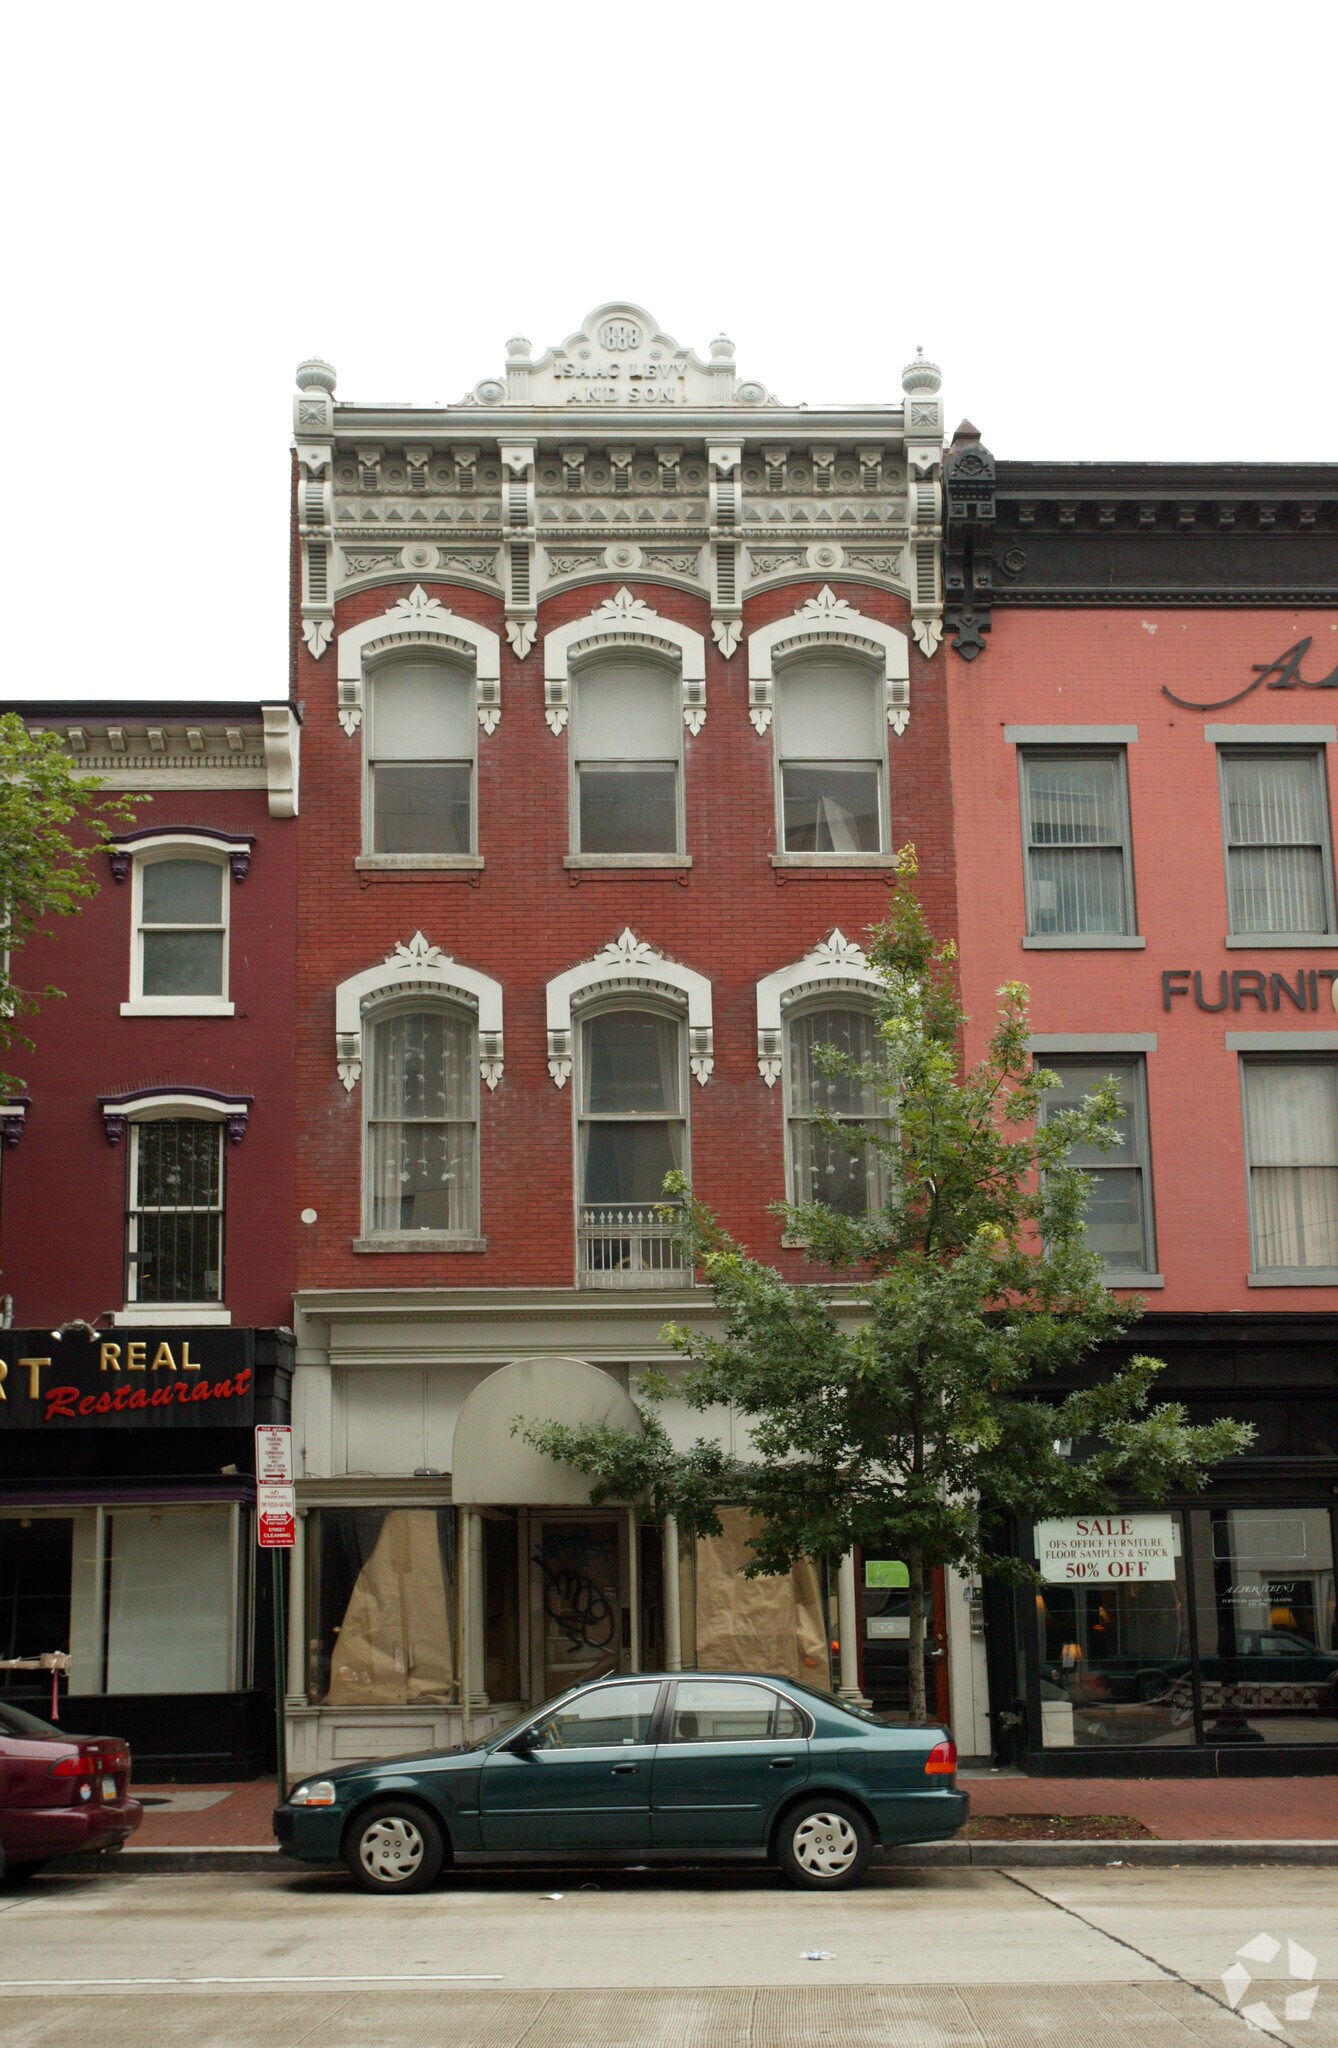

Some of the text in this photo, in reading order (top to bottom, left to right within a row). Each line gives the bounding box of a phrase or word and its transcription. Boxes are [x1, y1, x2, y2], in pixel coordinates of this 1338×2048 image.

[601, 326, 640, 351] 1888
[554, 363, 687, 380] ISAAC LEVY
[567, 387, 619, 403] AND
[101, 1341, 201, 1371] REAL
[45, 1368, 252, 1421] Restaurant
[1076, 1519, 1134, 1536] SALE
[1049, 1538, 1163, 1549] OFS OFFICE FURNITURE
[1045, 1550, 1077, 1559] FLOOR
[1080, 1549, 1125, 1558] SAMPLES
[1137, 1549, 1168, 1558] STOCK
[1065, 1561, 1149, 1578] 50% OFF
